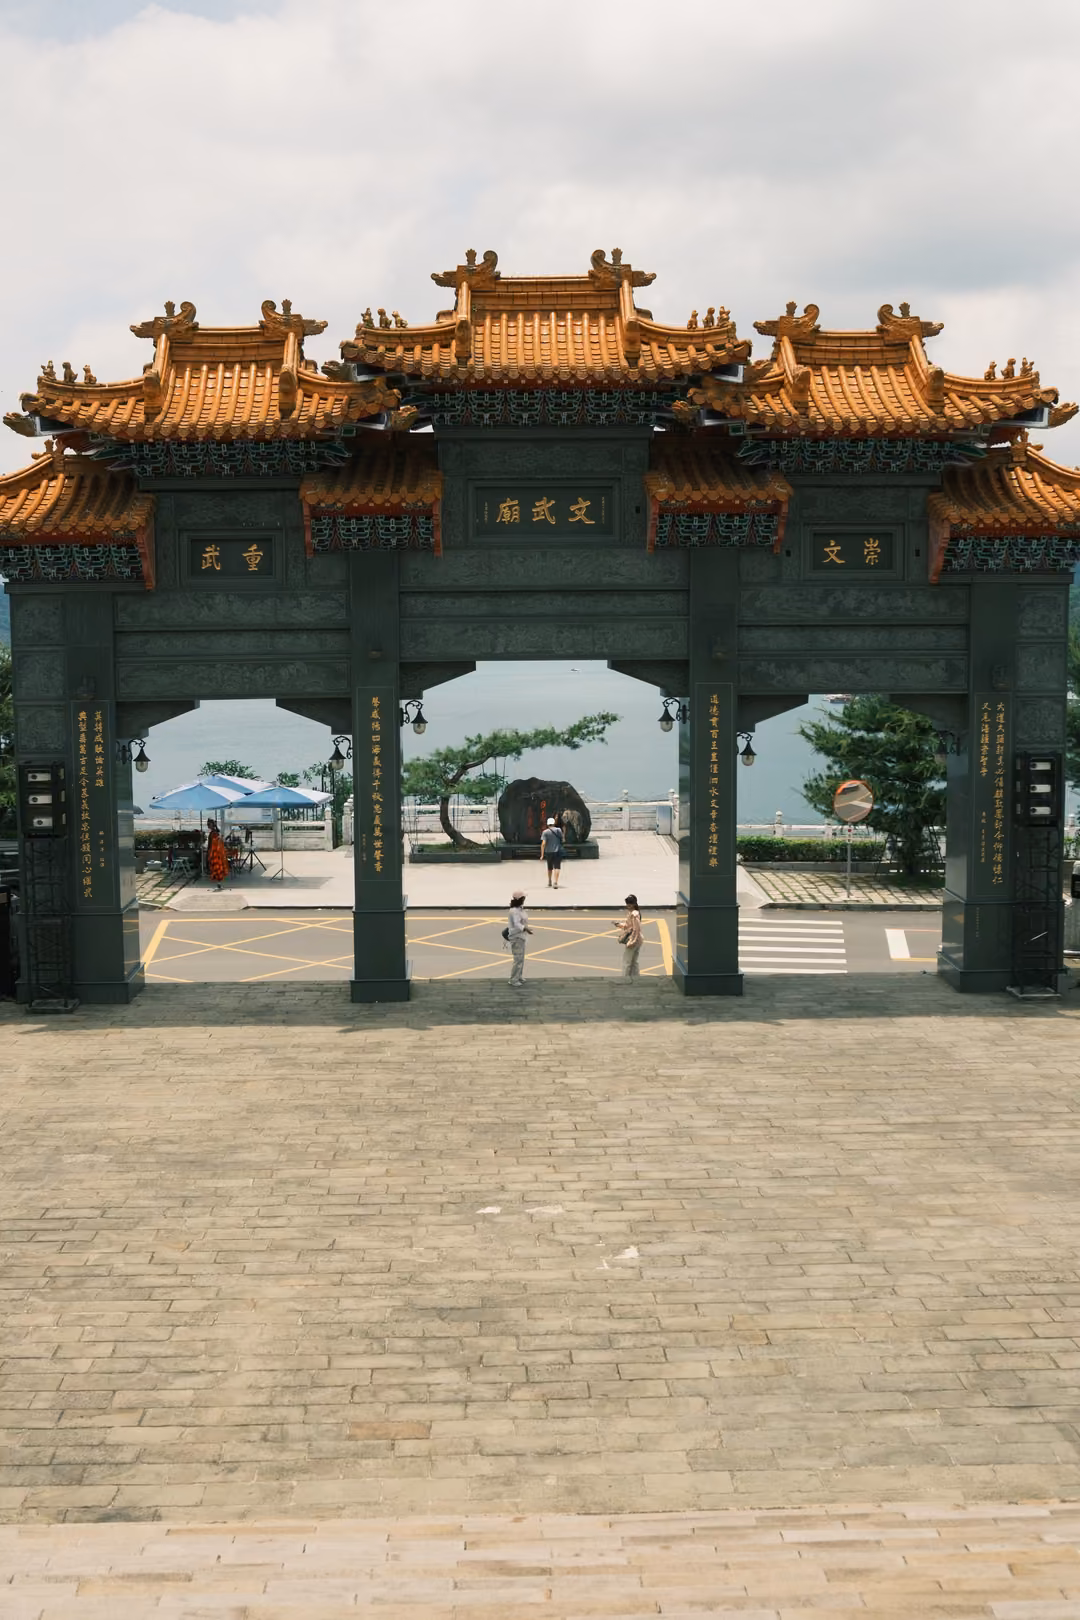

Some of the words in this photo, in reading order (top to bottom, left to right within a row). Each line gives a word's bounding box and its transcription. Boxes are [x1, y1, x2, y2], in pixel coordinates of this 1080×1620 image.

[496, 497, 596, 525] 文武廟
[201, 544, 264, 571] 重武
[821, 537, 881, 566] 崇文
